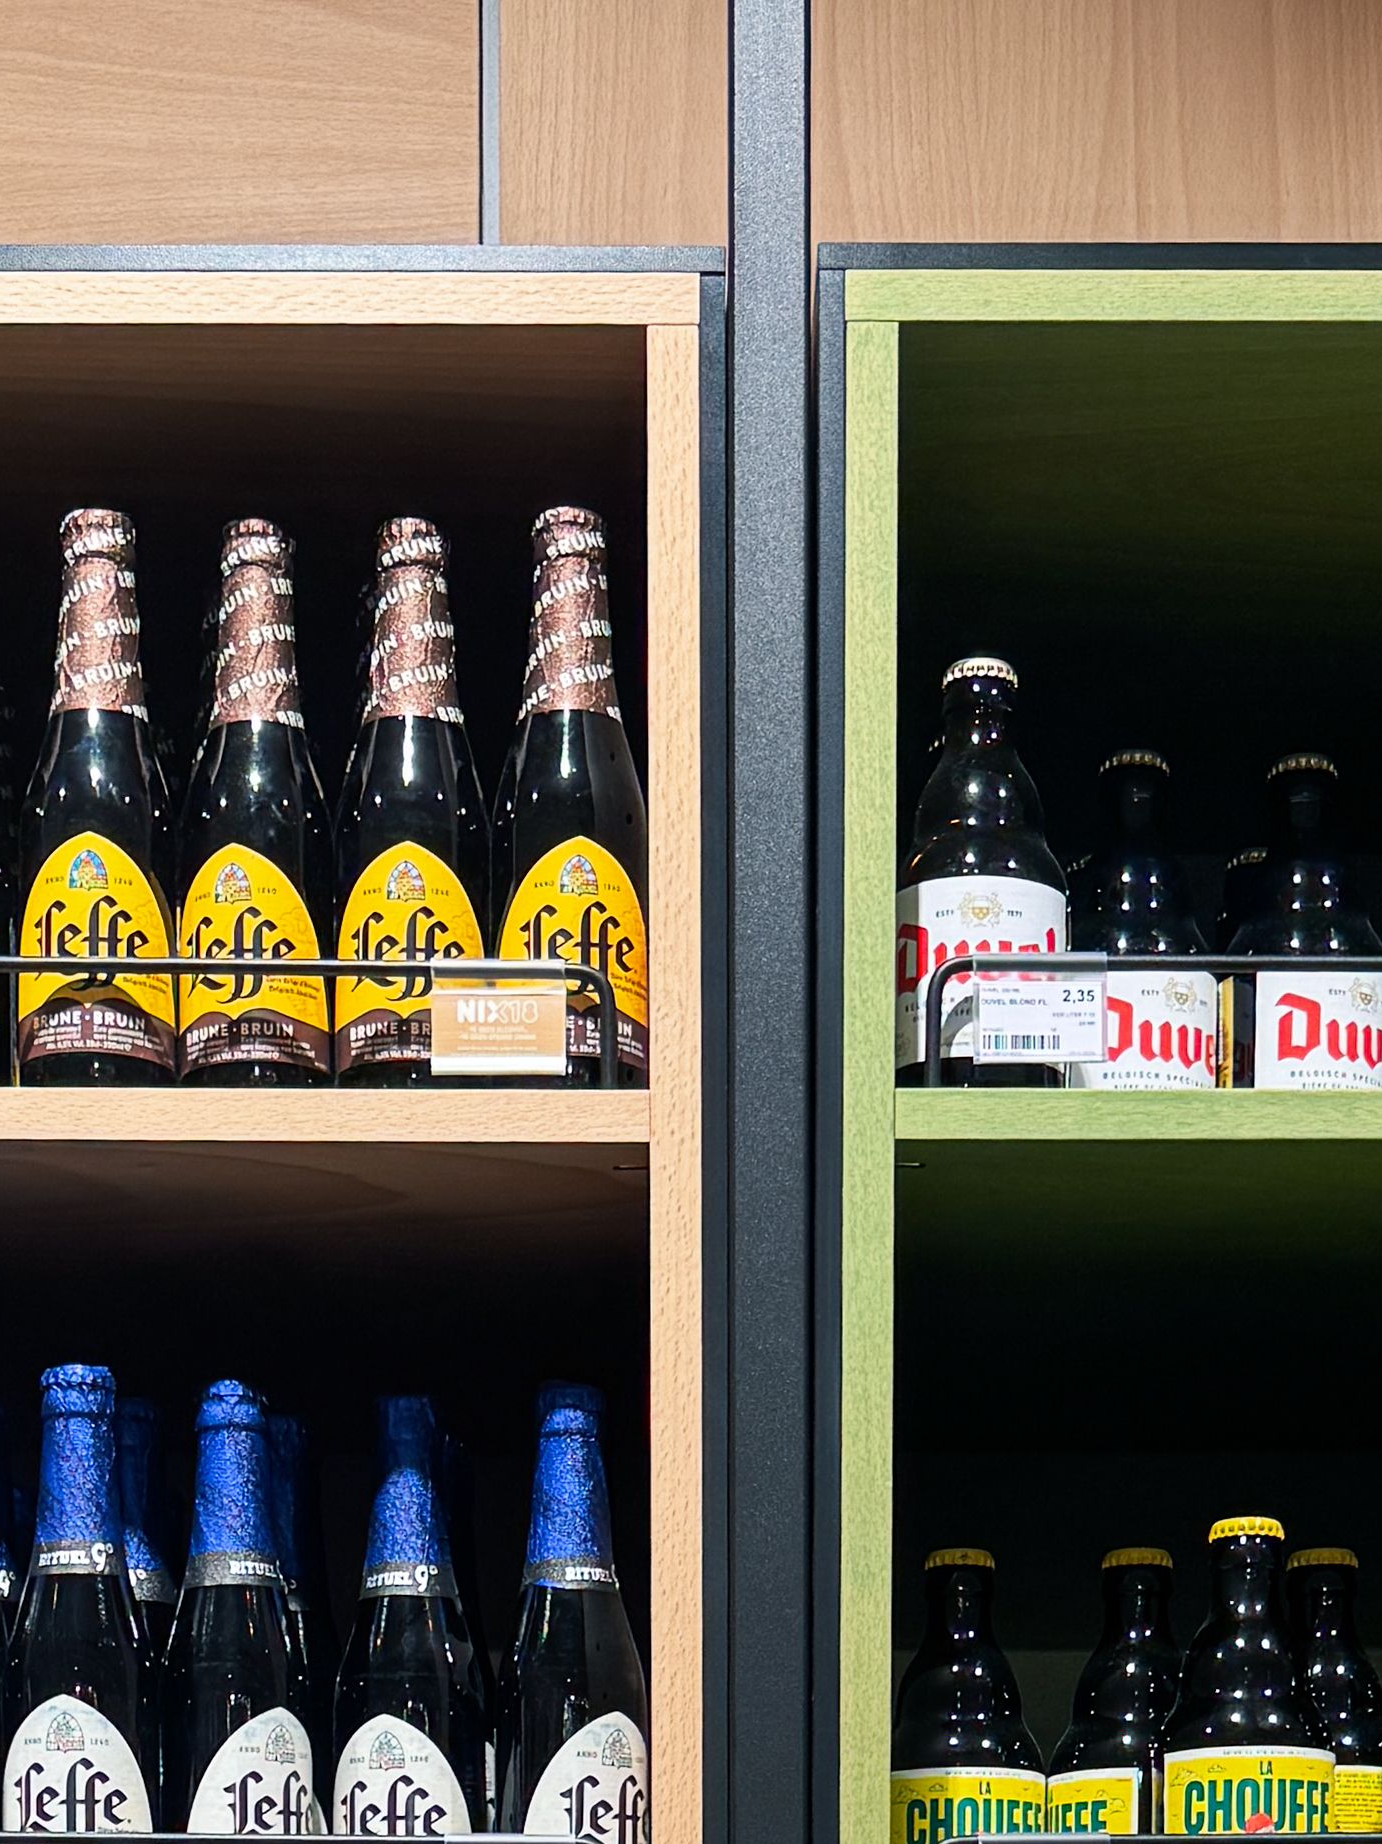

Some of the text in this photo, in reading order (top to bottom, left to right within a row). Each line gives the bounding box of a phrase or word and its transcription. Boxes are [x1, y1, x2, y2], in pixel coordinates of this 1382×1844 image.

[35, 896, 148, 987] Leffe
[187, 905, 296, 1003] Leffe
[1063, 989, 1096, 1004] 2,35
[92, 1010, 145, 1031] BRUIN
[457, 998, 539, 1024] NIX18
[241, 1019, 294, 1038] BRUIN
[1259, 1760, 1274, 1777] LA
[1183, 1777, 1331, 1834] CHOUFFE
